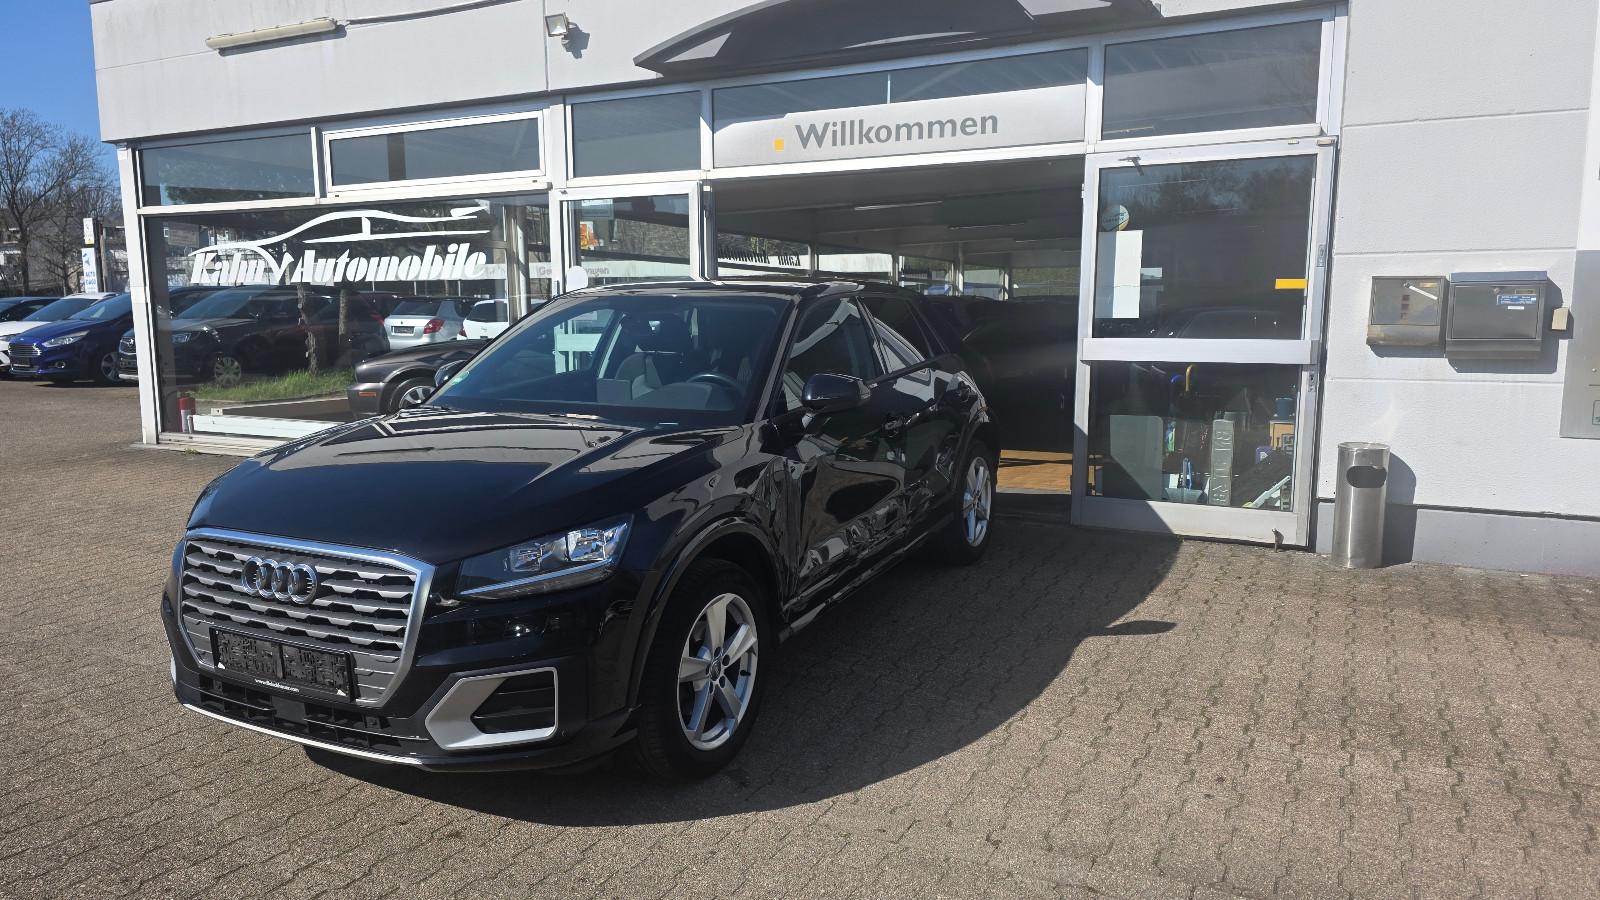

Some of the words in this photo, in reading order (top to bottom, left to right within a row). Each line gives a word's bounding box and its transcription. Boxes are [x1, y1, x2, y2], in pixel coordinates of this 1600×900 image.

[795, 114, 998, 149] Willkommen
[190, 252, 267, 283] Kahn
[291, 243, 487, 283] Automobile
